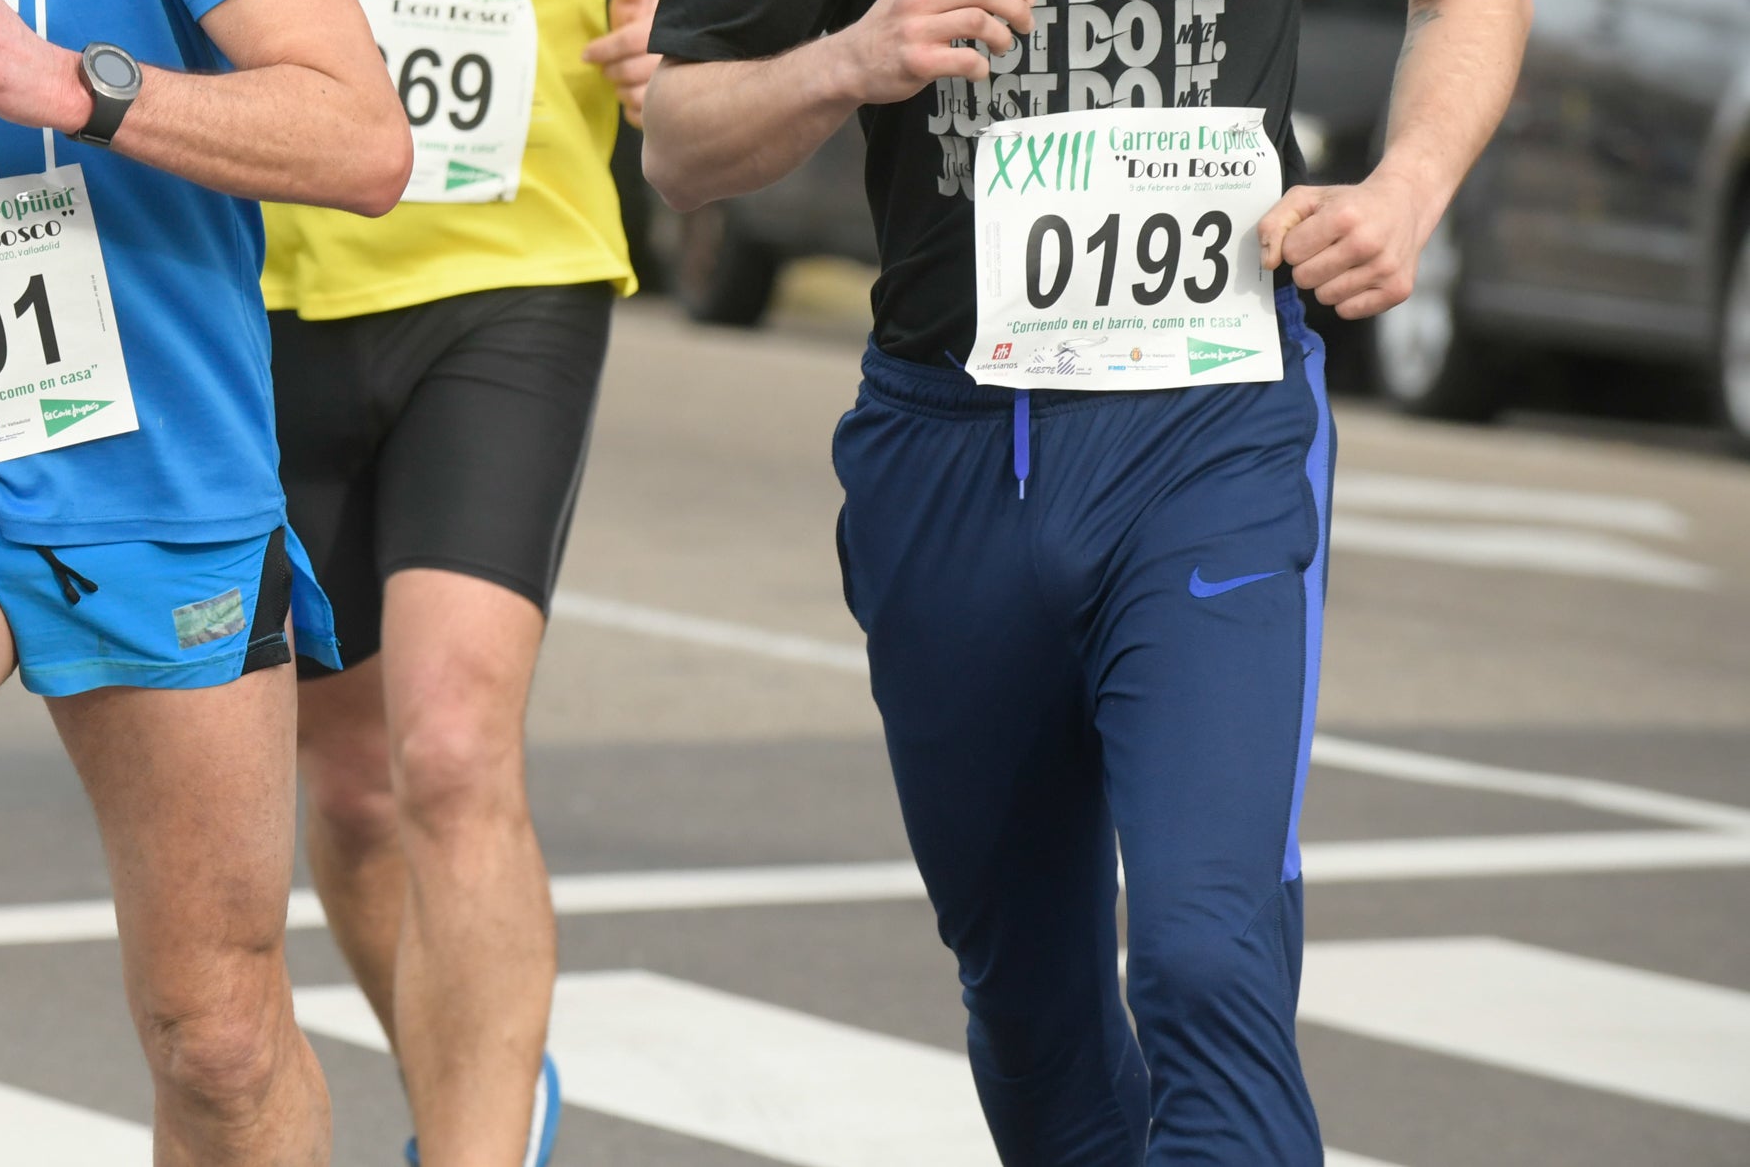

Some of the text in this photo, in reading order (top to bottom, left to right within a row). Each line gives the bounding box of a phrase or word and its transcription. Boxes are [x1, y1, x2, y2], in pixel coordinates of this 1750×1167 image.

[1068, 0, 1162, 70] DO
[380, 44, 493, 131] 69
[988, 130, 1096, 196] XXIII
[1109, 126, 1191, 151] Carrera
[1149, 184, 1180, 192] febrero
[18, 241, 61, 258] Valladolid
[1026, 210, 1232, 310] 0193
[1072, 319, 1088, 330] en
[1093, 317, 1104, 330] el
[1108, 316, 1147, 330] barrio,
[1152, 317, 1185, 329] como
[1190, 317, 1204, 328] en
[0, 384, 35, 401] como
[40, 377, 56, 391] en
